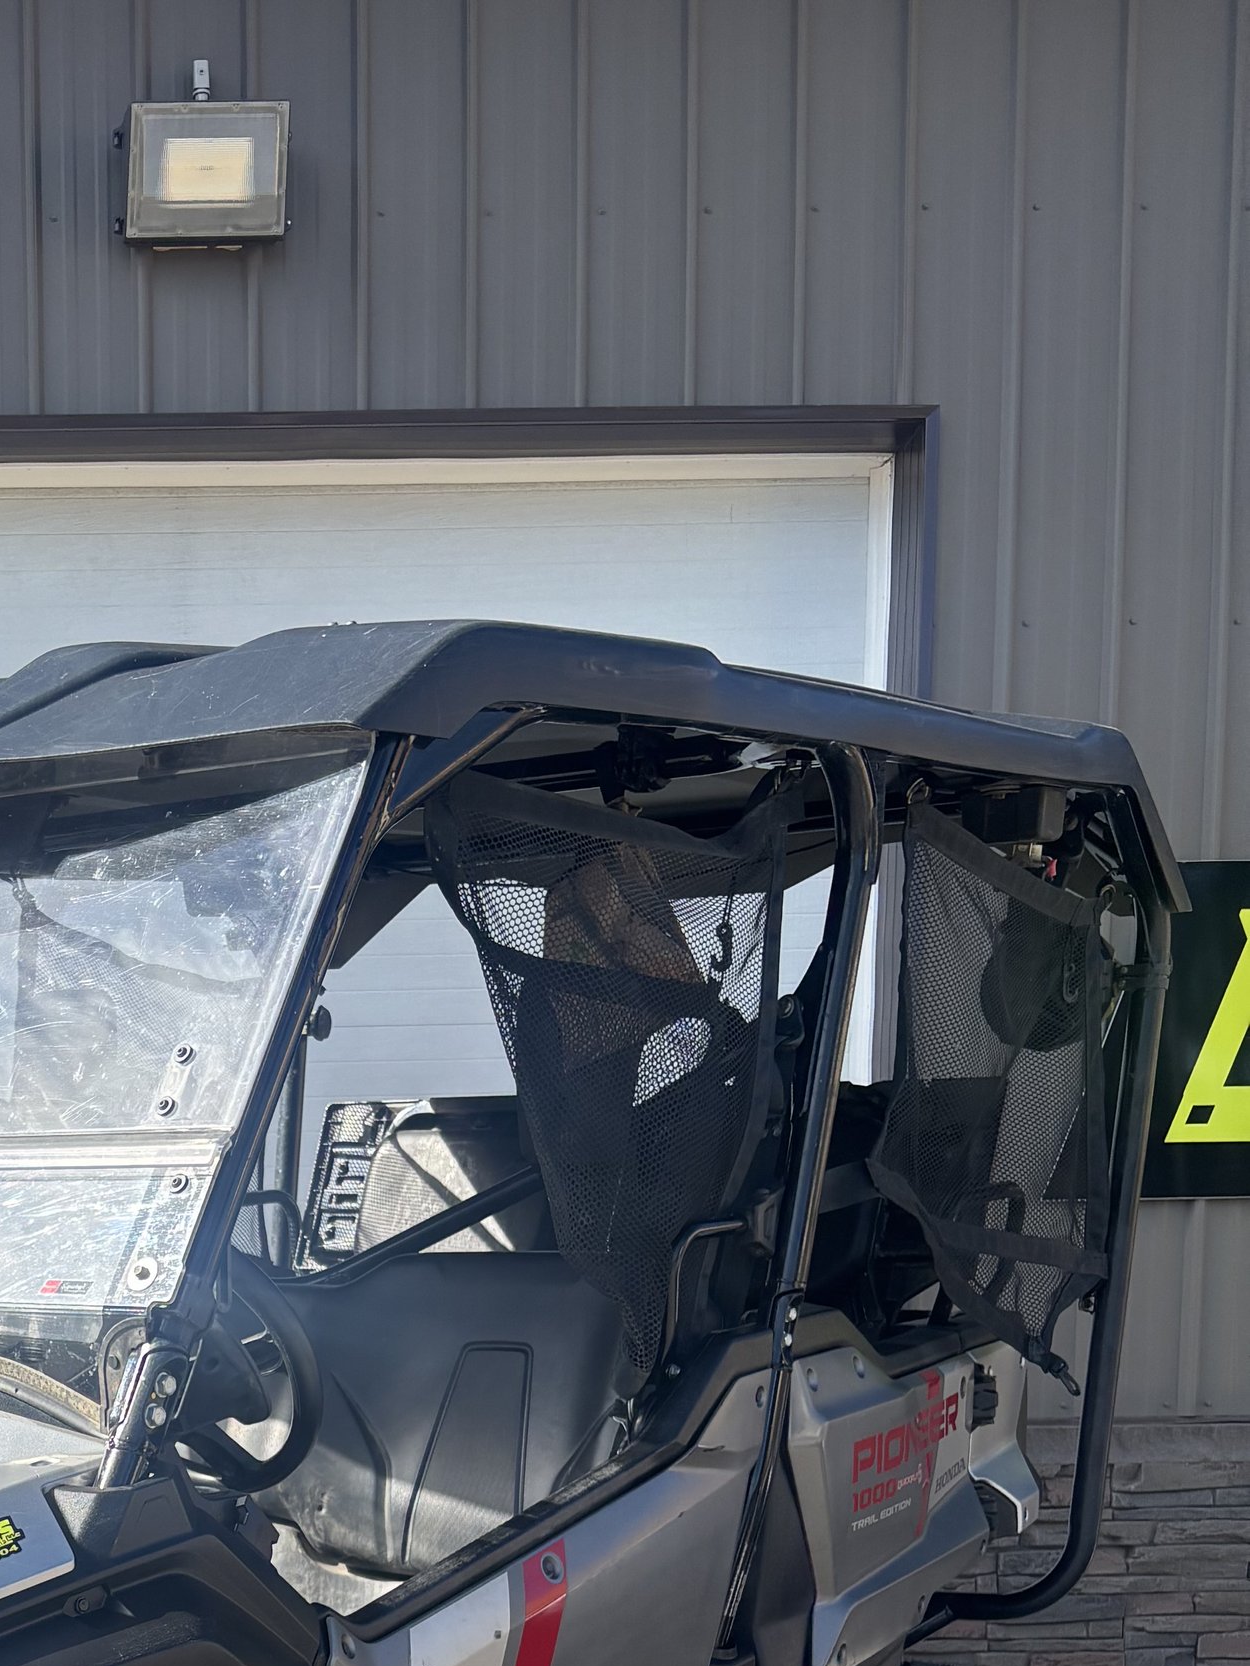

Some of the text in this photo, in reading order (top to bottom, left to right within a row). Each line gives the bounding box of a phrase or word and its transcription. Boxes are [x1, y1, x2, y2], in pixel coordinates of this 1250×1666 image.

[935, 1457, 966, 1494] HONDA
[853, 1478, 899, 1513] 1000
[851, 1498, 912, 1532] TRAIL EDITION
